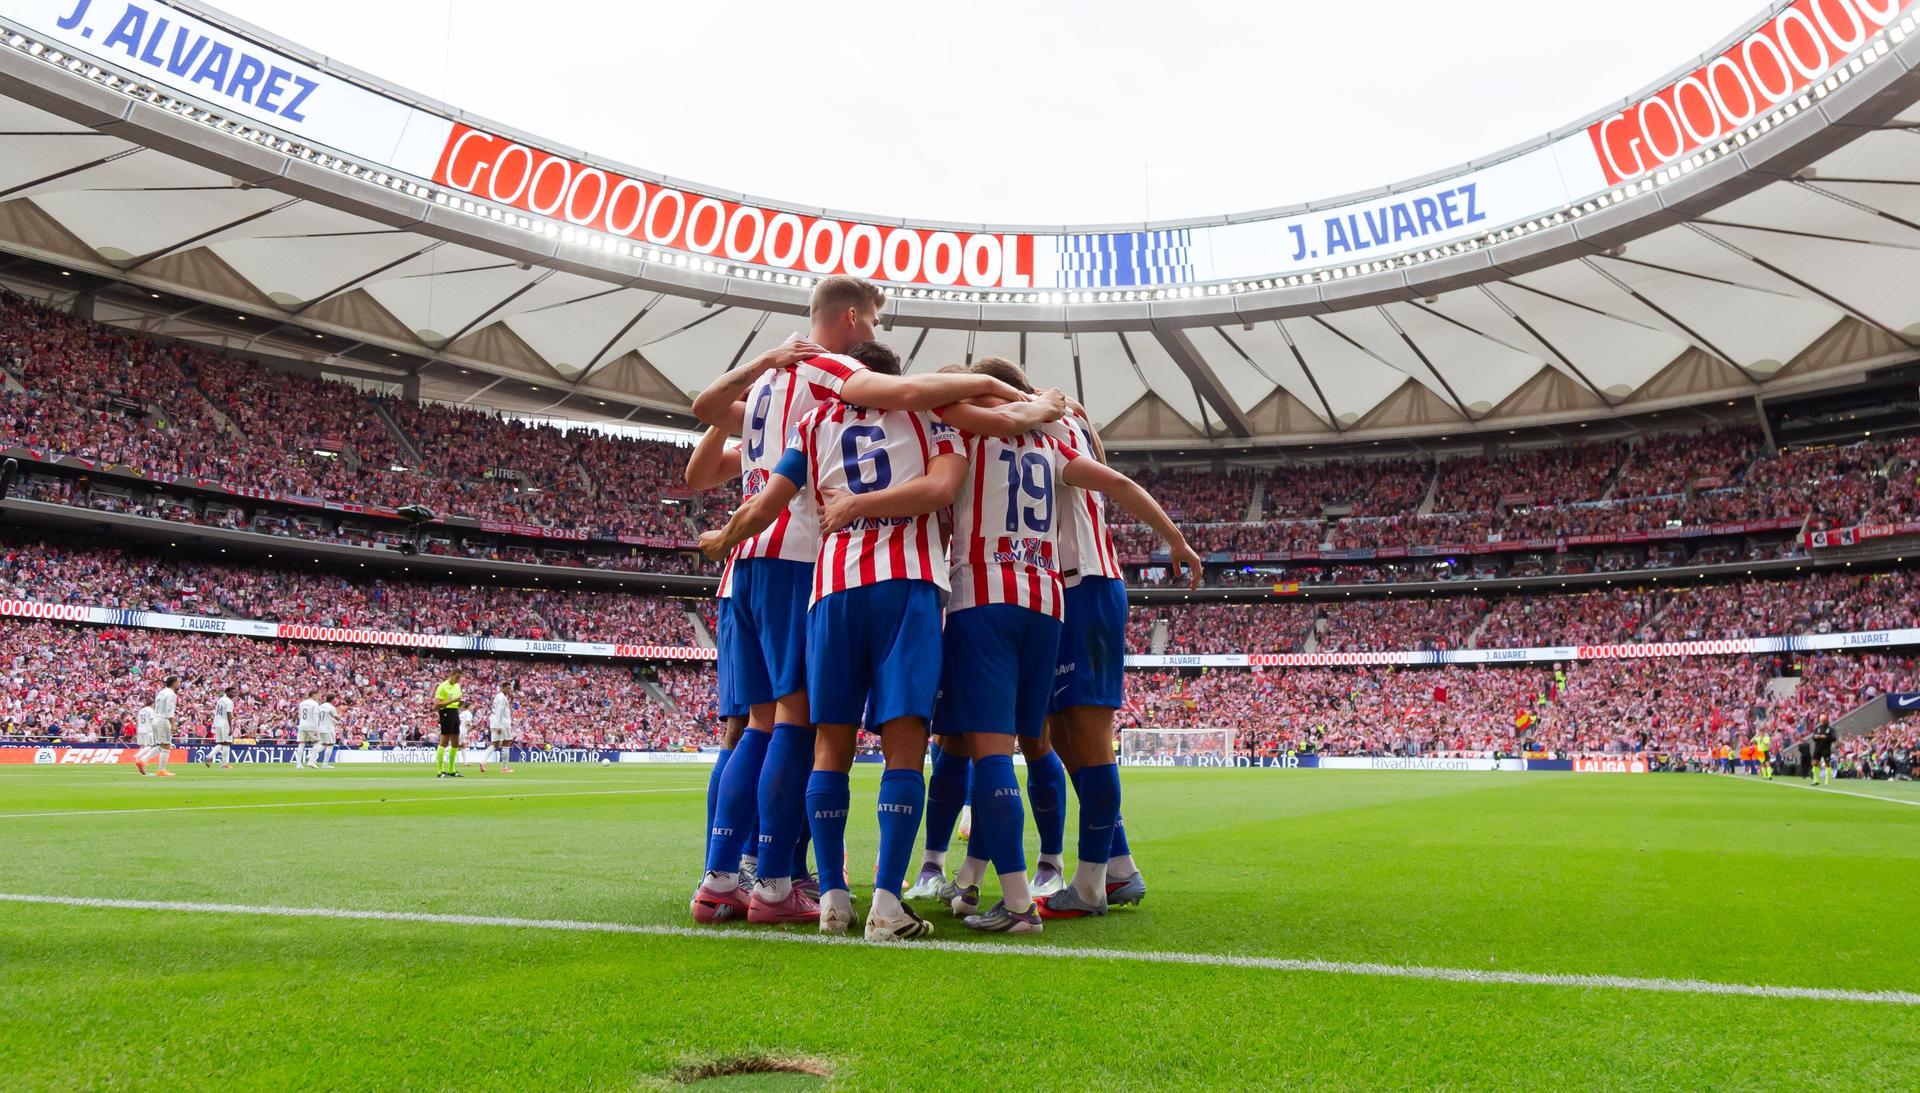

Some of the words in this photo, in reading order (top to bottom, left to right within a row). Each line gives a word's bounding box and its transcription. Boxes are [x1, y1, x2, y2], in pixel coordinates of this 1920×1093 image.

[56, 0, 93, 39] J.
[102, 3, 320, 123] ALVAREZ
[1287, 223, 1318, 261] J.
[1325, 182, 1486, 255] ALVAREZ
[748, 383, 772, 463] 9
[841, 425, 893, 494] 6
[998, 449, 1054, 533] 19
[180, 617, 188, 629] J.
[188, 617, 226, 632] ALVAREZ
[1850, 633, 1890, 646] ALVAREZ
[533, 642, 566, 652] ALVAREZ
[1169, 656, 1201, 665] ALVAREZ
[1493, 650, 1527, 660] ALVAREZ
[39, 751, 52, 760] EA
[1579, 761, 1632, 774] LALIGA
[878, 803, 913, 815] ATLETI
